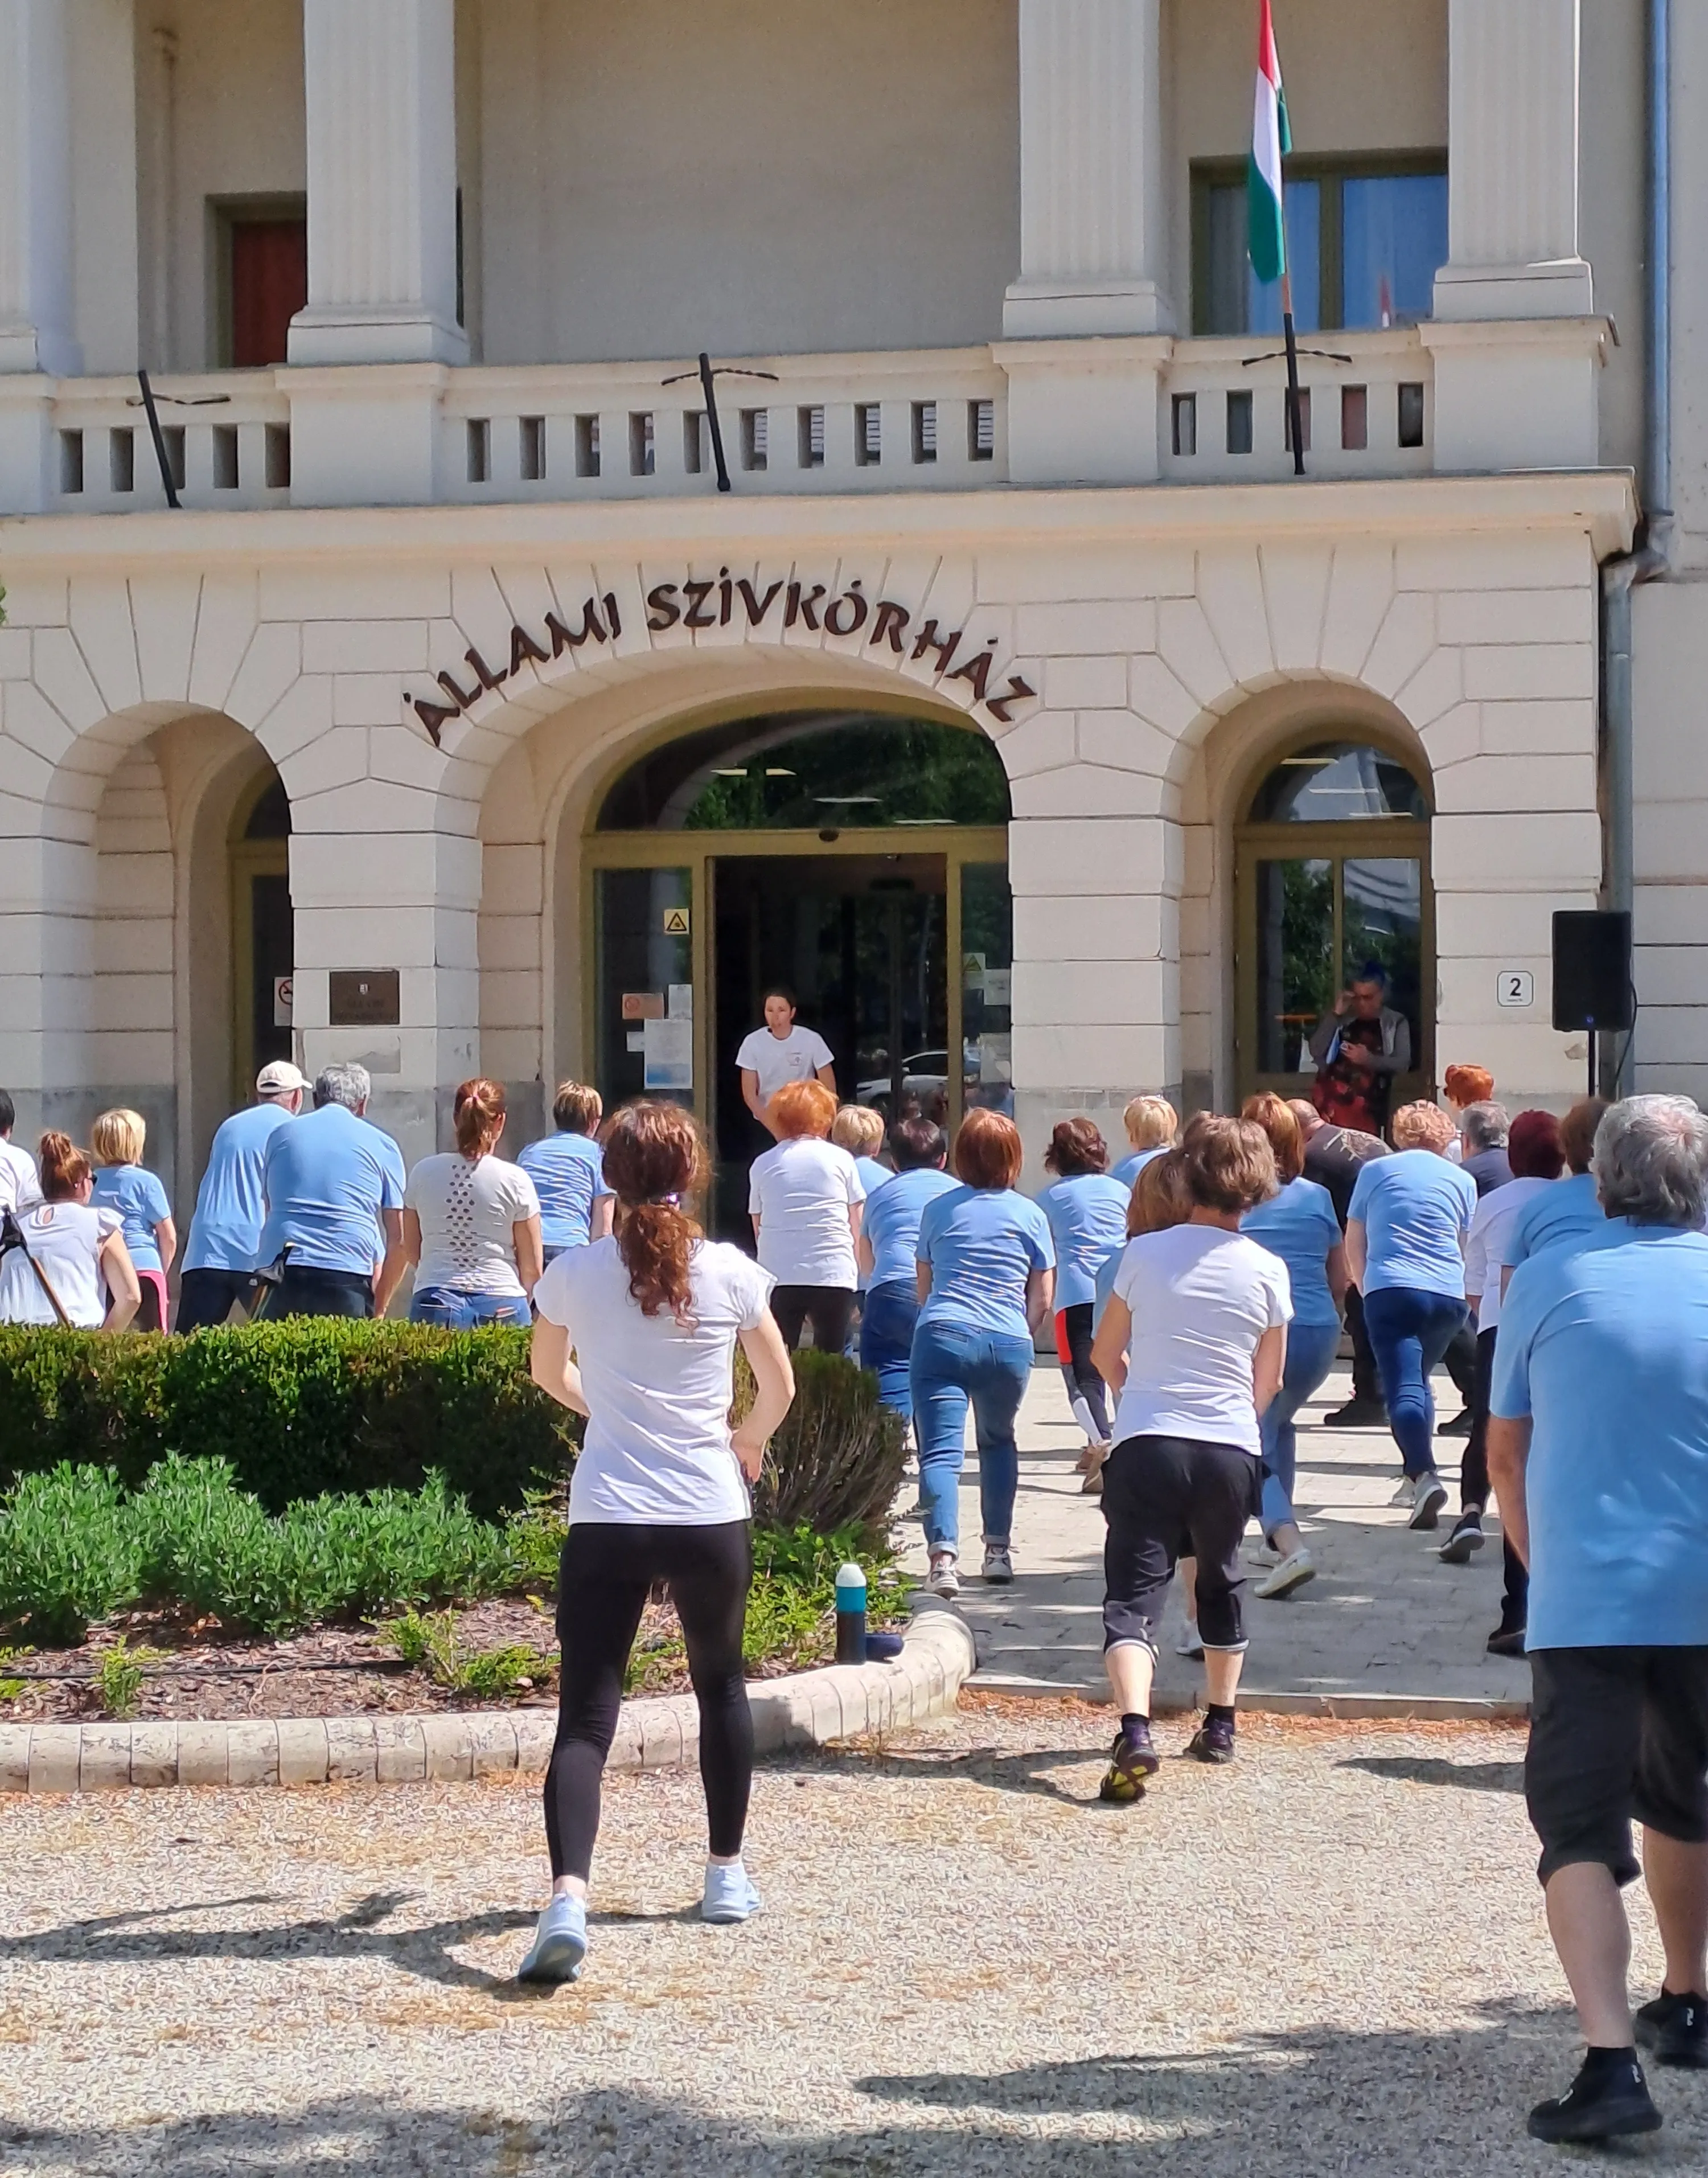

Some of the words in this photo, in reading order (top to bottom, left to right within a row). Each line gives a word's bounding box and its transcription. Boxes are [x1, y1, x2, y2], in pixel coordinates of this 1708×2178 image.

[402, 592, 622, 748] ÁLLAMI
[647, 565, 1037, 722] SZÍVKÓRHÁZ
[1510, 977, 1521, 996] 2
